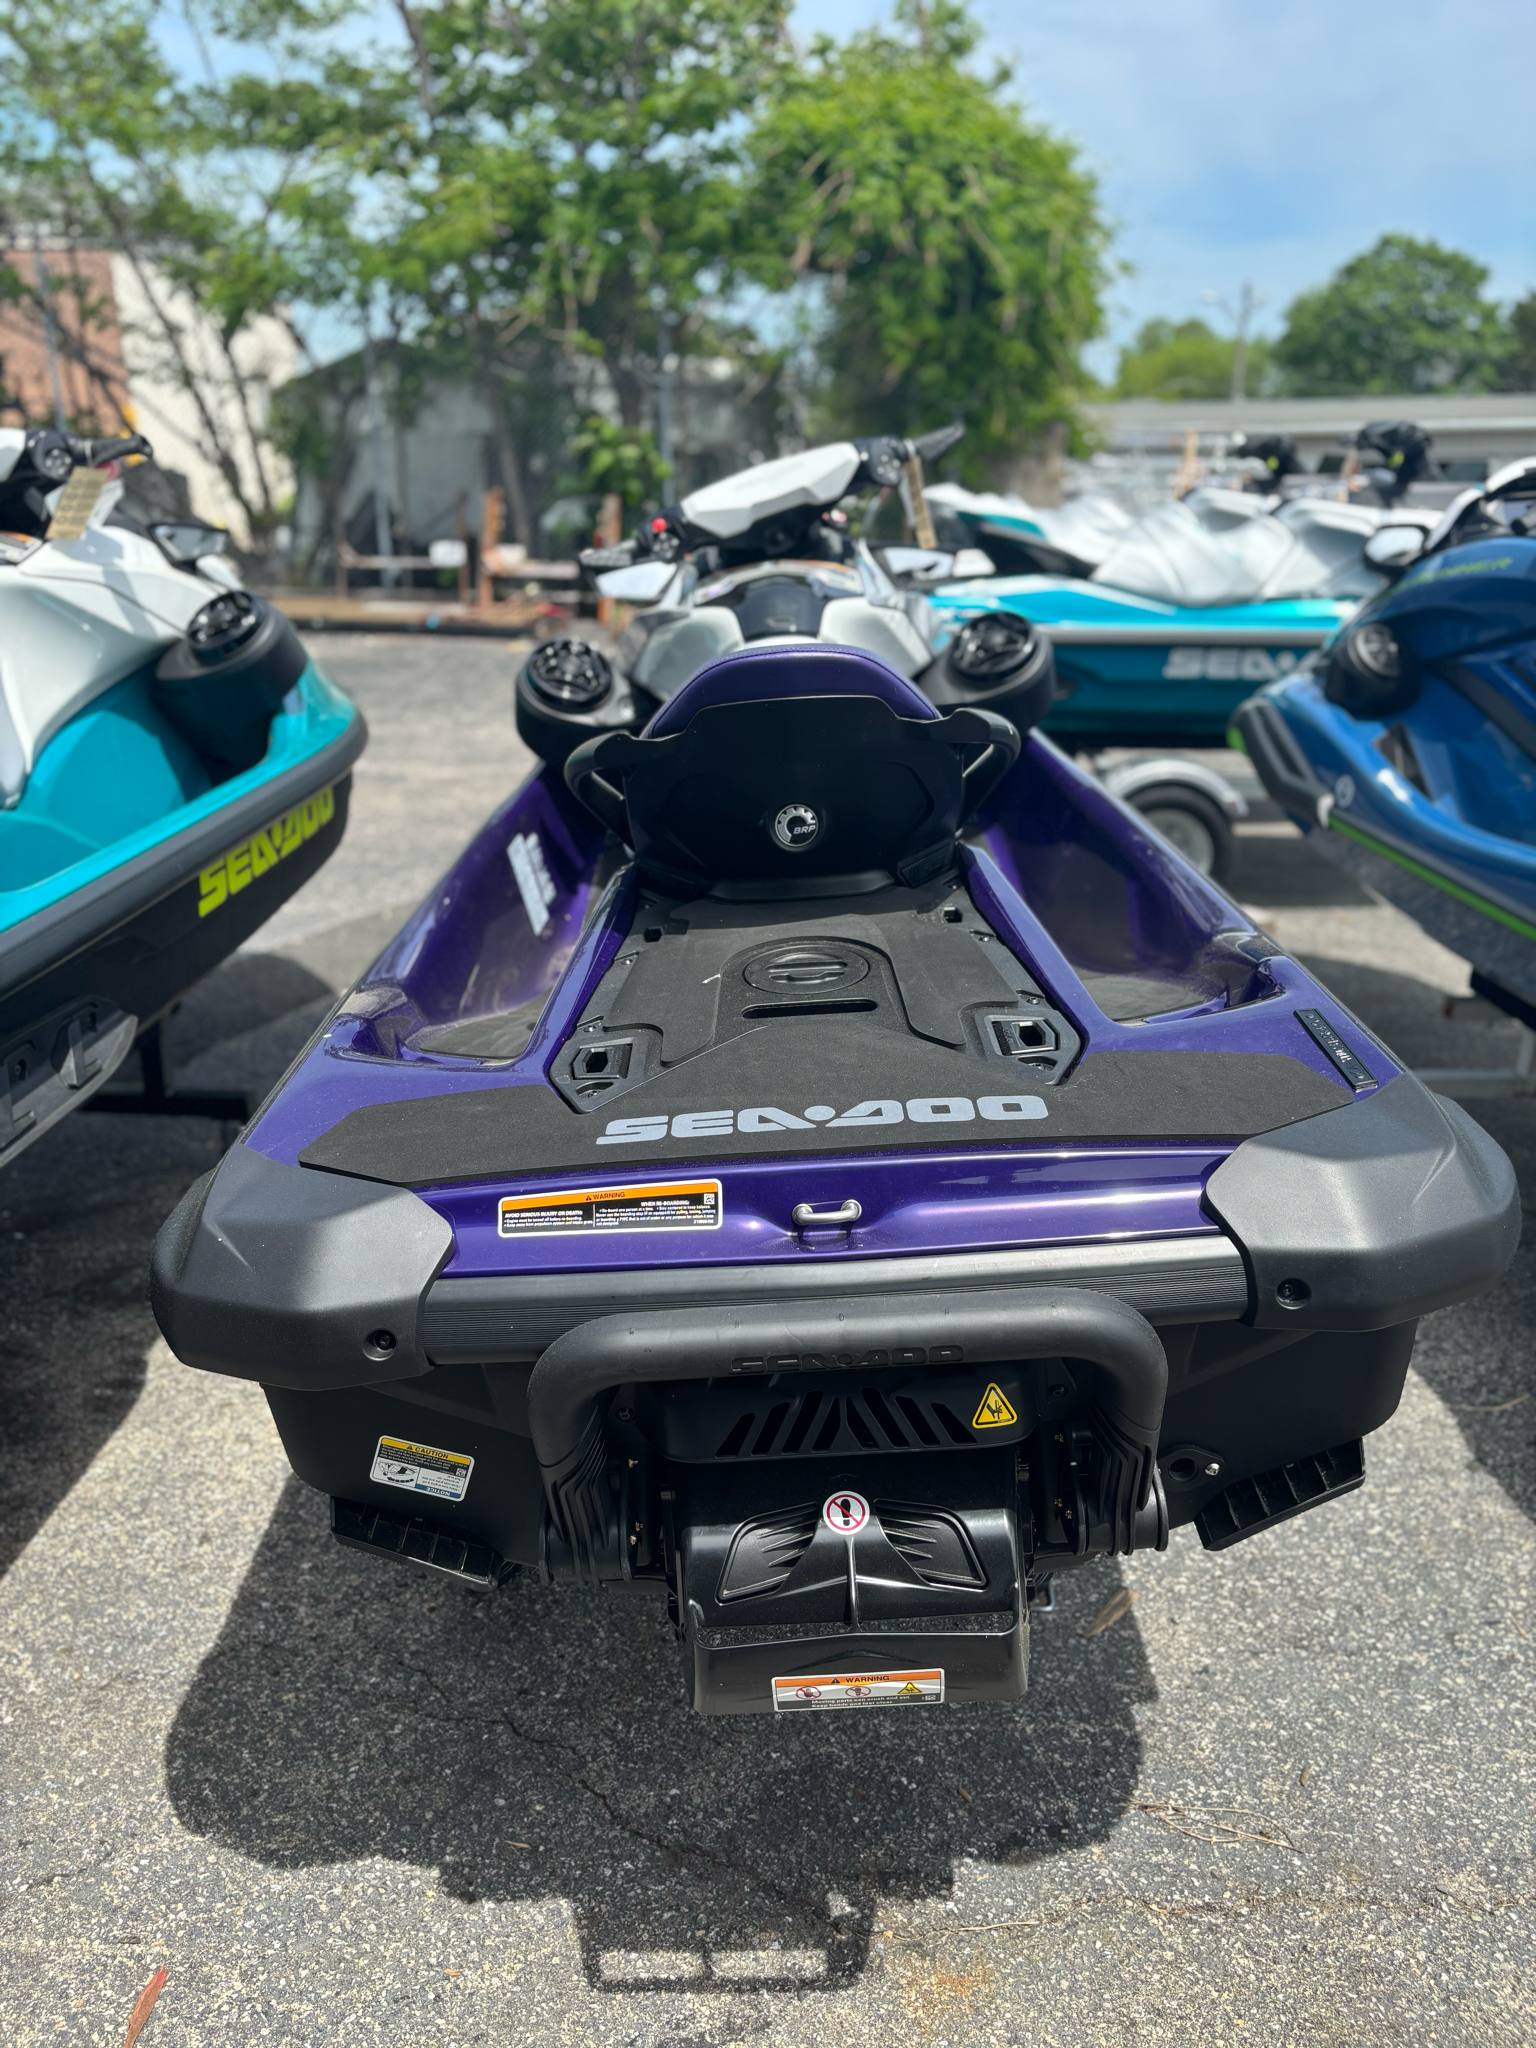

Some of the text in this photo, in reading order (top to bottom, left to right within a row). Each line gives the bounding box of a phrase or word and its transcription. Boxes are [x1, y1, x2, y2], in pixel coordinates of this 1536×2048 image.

[793, 825, 816, 835] BRP
[593, 1191, 625, 1200] WARNING
[415, 1446, 449, 1459] CAUTION
[426, 1486, 451, 1496] NOTICE
[845, 1675, 890, 1684] WARNING
